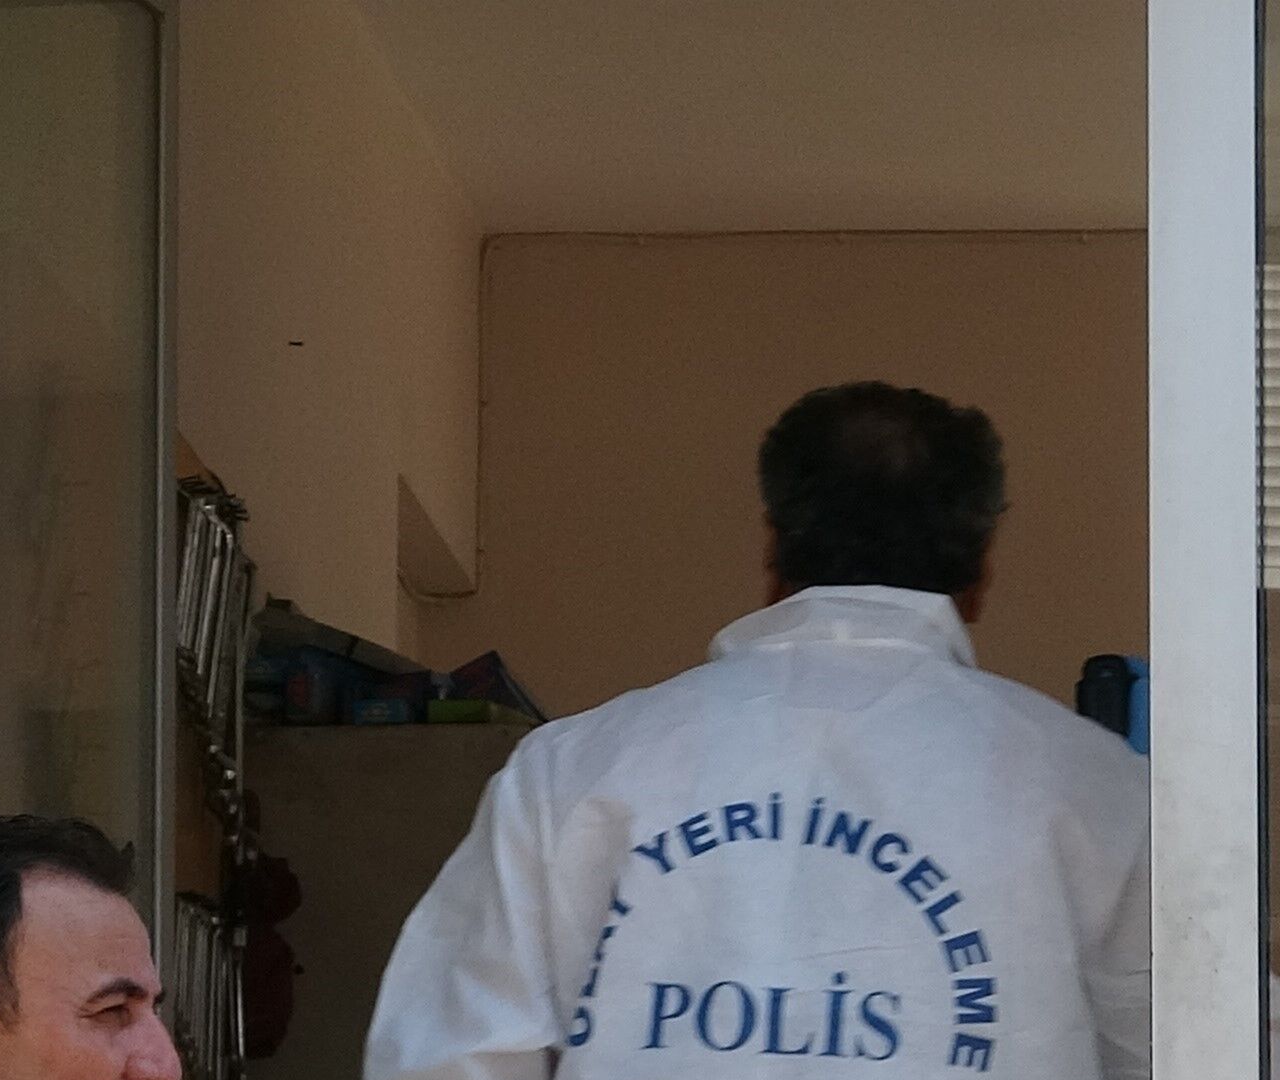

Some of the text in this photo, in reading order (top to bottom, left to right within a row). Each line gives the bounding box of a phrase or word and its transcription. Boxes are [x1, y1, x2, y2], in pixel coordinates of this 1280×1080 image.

[633, 793, 783, 874] YERİ
[803, 797, 999, 1074] İNCELEME
[641, 971, 902, 1062] POLİS
